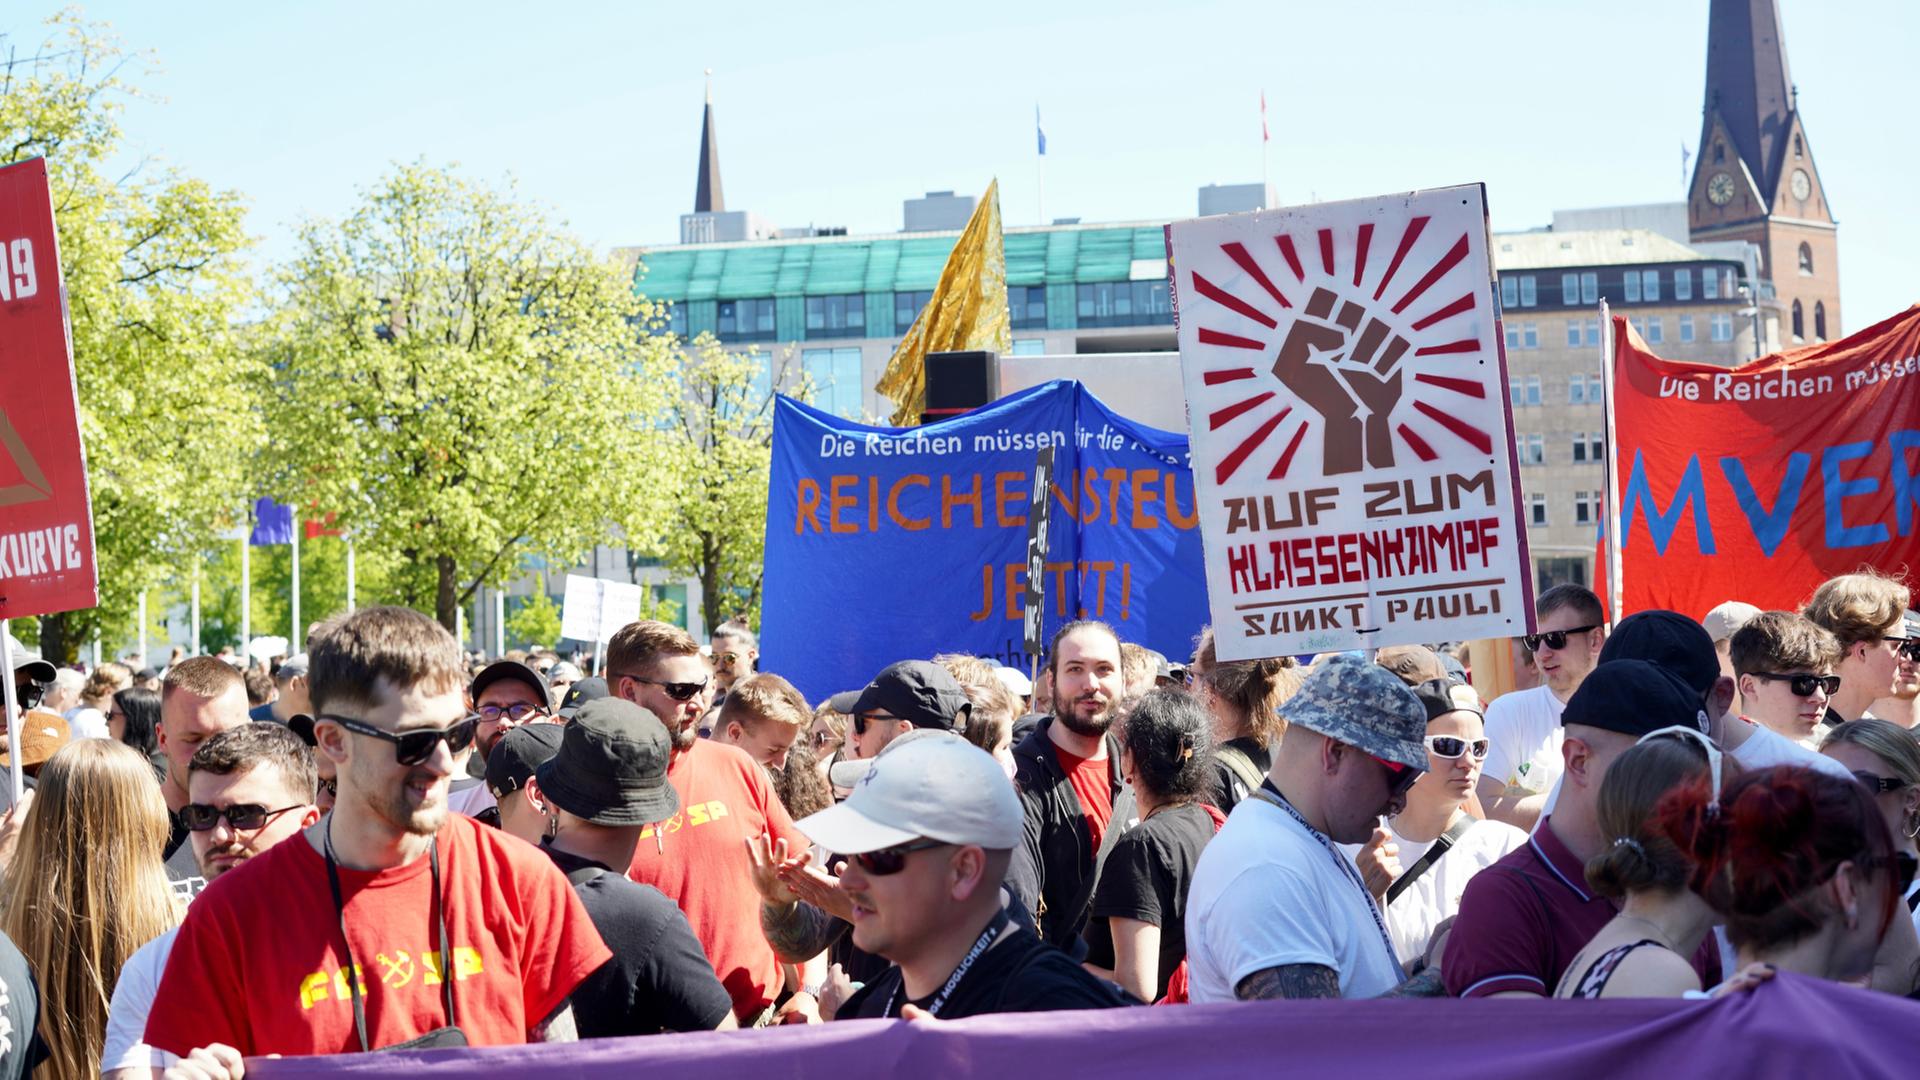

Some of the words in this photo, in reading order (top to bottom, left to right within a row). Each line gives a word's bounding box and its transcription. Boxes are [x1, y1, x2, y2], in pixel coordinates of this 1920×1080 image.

[1713, 366, 1833, 401] Reichen
[1846, 355, 1920, 391] müsse
[820, 434, 856, 458] Die
[864, 432, 962, 457] Reichen
[974, 429, 1066, 452] müssen
[1097, 424, 1125, 451] die
[1223, 487, 1340, 534] AUF
[1363, 470, 1497, 519] ZUM
[1227, 517, 1499, 594] KLASSENKAMPF
[1244, 603, 1364, 637] SANKT
[1387, 589, 1502, 622] PAULI
